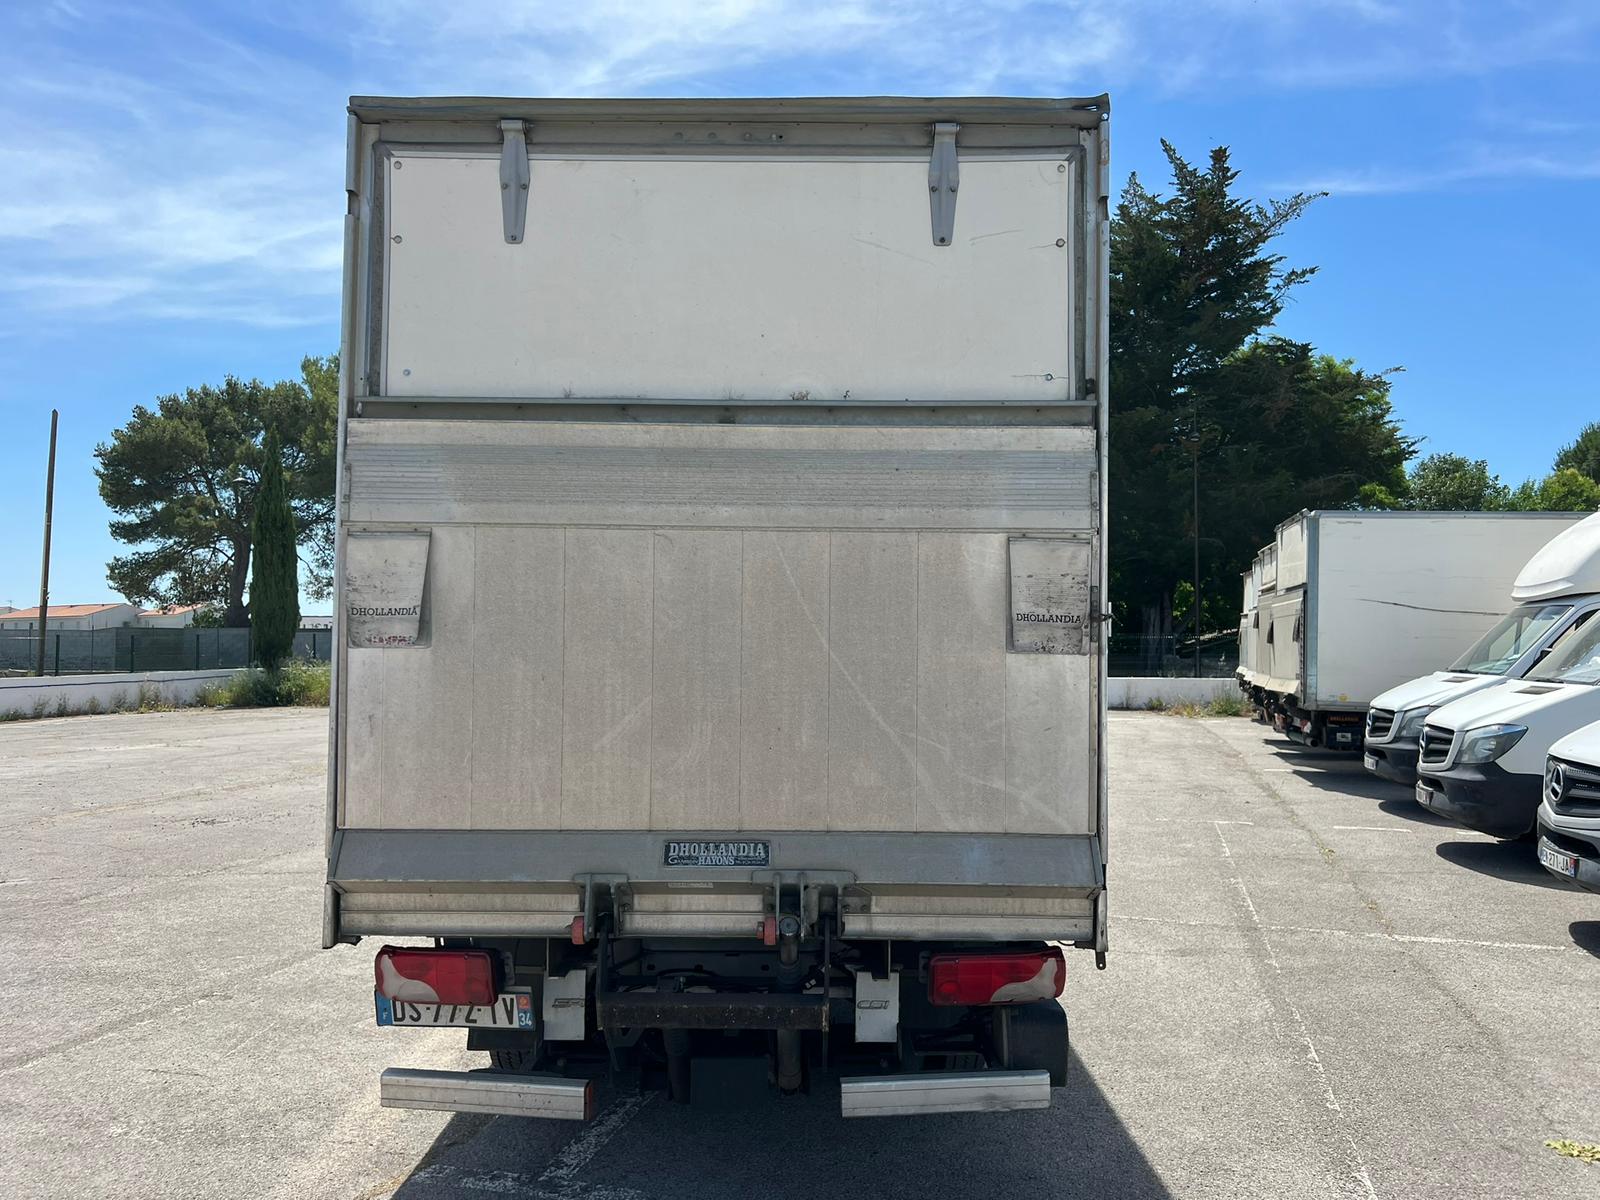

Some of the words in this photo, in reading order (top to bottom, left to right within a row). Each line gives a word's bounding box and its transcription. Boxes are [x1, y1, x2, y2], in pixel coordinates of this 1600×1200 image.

[351, 607, 418, 617] DHOLLANDIA
[1016, 613, 1082, 623] DHOLLANDIA
[669, 842, 766, 856] DHOLLANDIA
[698, 856, 735, 865] HAYONS
[518, 1012, 532, 1027] 34
